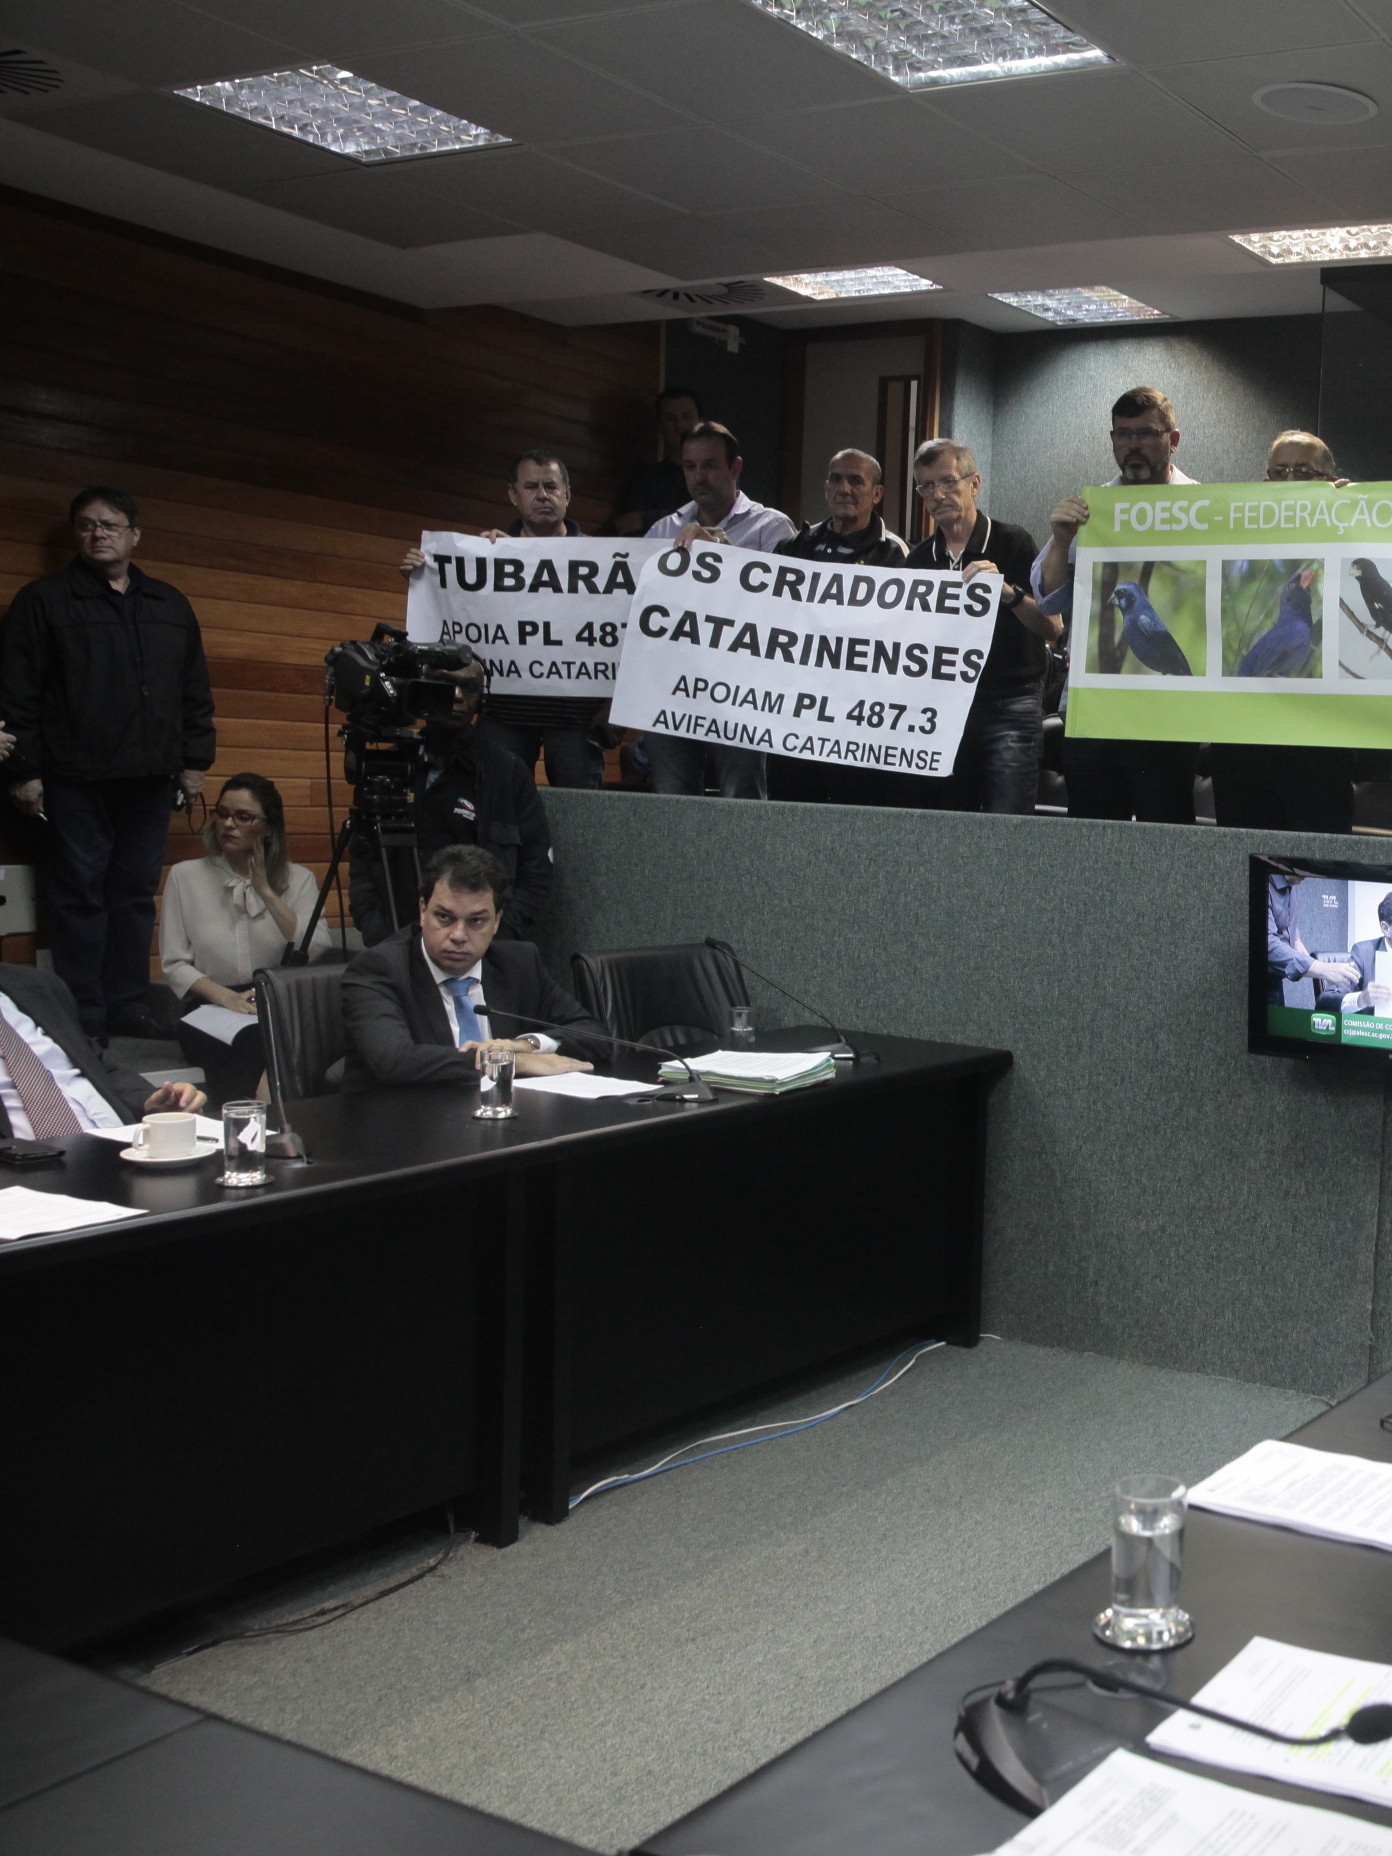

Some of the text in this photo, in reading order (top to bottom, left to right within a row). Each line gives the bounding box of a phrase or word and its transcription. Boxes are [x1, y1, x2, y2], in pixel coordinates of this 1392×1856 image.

[1113, 499, 1210, 532] FOESC
[433, 551, 637, 596] TUBARÃ
[657, 546, 993, 618] OS CRIADORES
[439, 619, 510, 646] APOIA
[517, 620, 563, 646] PL
[638, 604, 985, 684] CATARINENSES
[528, 659, 620, 681] CATARI
[671, 674, 938, 735] APOIAM PL 487.3
[652, 709, 943, 772] AVIFAUNA CATARINENSE
[1343, 1018, 1375, 1030] COMISSÃO
[1375, 1022, 1384, 1030] DE
